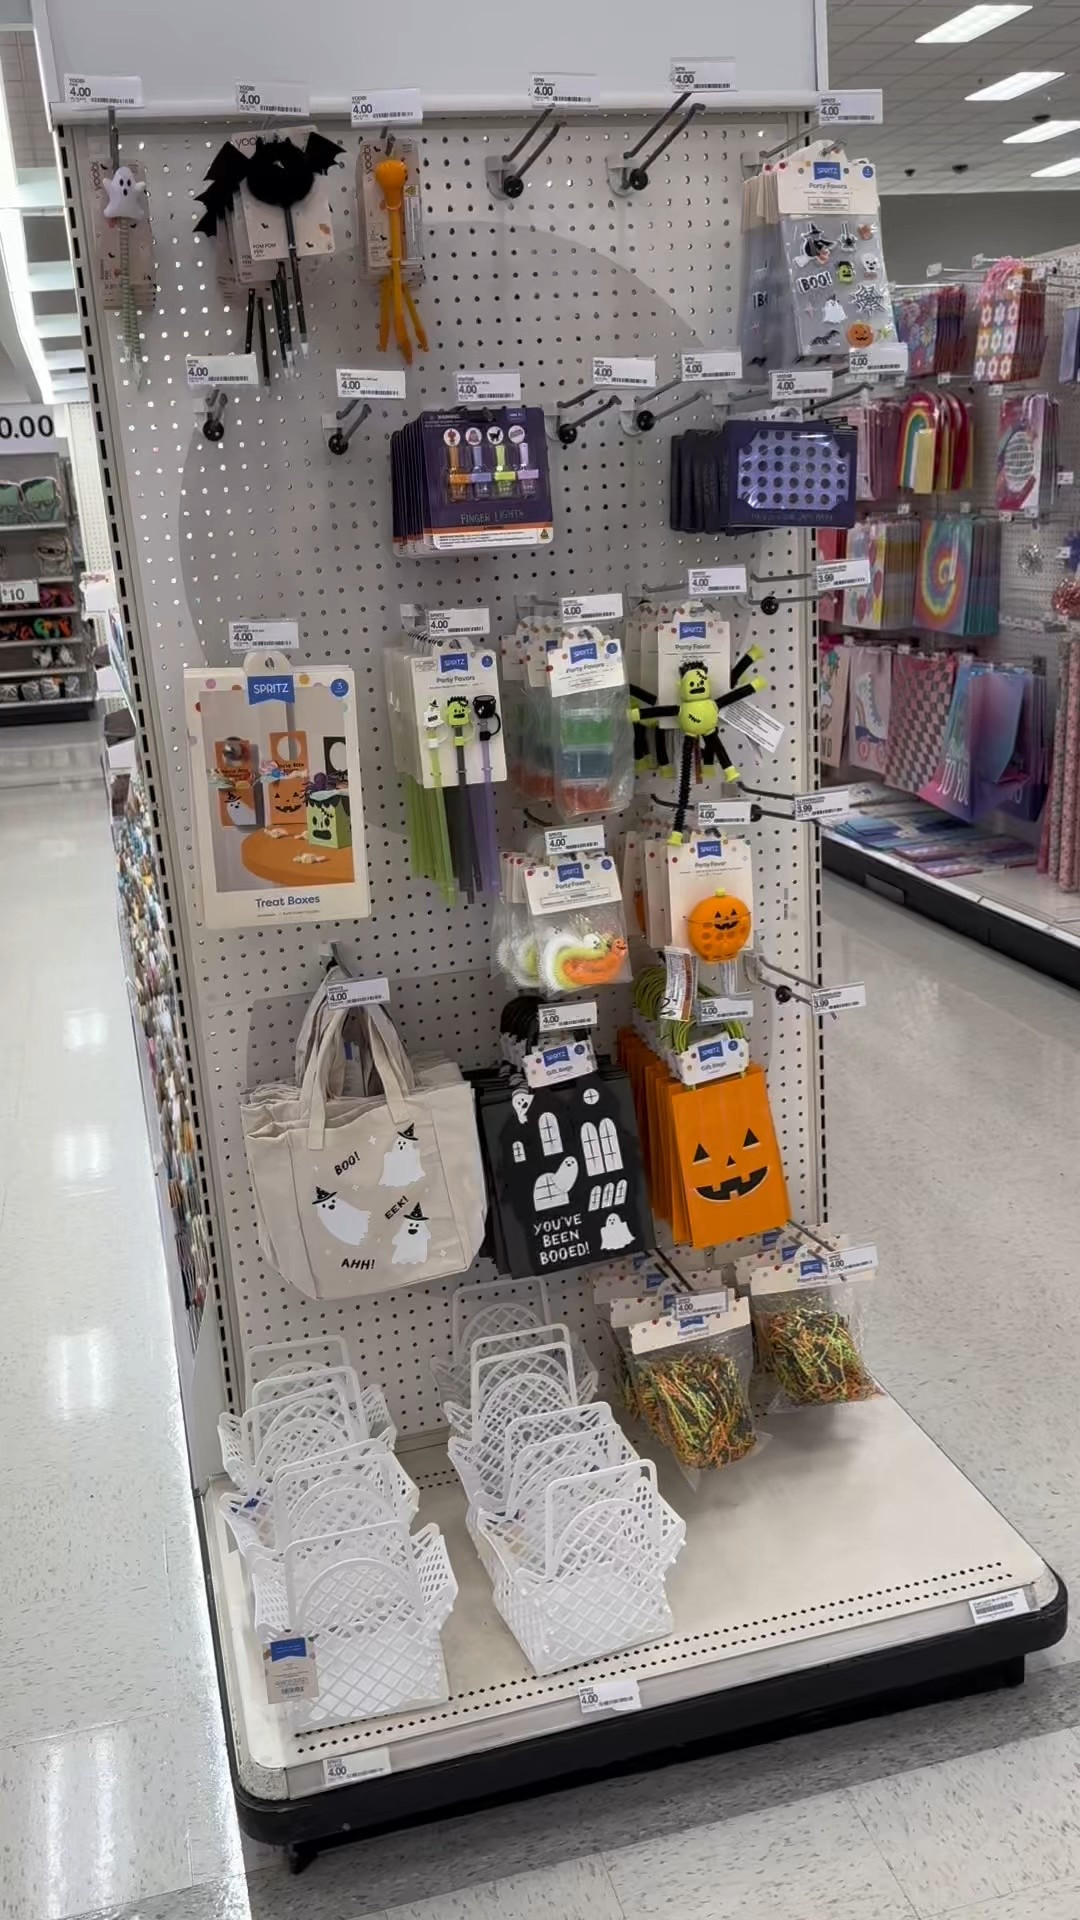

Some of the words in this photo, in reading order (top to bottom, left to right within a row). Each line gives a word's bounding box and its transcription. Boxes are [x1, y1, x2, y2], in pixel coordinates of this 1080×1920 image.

[676, 75, 694, 84] 4.00
[70, 87, 91, 97] 4.00
[534, 87, 553, 96] 4.00
[240, 95, 260, 105] 4.00
[353, 104, 373, 114] 4.00
[821, 106, 839, 115] 4.00
[851, 357, 868, 366] 4.00
[187, 367, 208, 377] 4.00
[594, 368, 612, 377] 4.00
[685, 364, 702, 373] 4.00
[342, 381, 361, 390] 4.00
[458, 385, 477, 394] 4.00
[777, 381, 794, 390] 4.00
[461, 512, 490, 524] FINGER
[563, 606, 581, 615] 4.00
[430, 620, 448, 629] 4.00
[234, 633, 253, 641] 4.00
[253, 682, 289, 694] SPRITZ
[700, 811, 715, 819] 4.00
[549, 838, 566, 848] 4.00
[255, 898, 285, 908] Treat
[287, 896, 320, 905] Boxes
[329, 993, 347, 1002] 4.00
[702, 1007, 718, 1015] 4.00
[543, 1015, 560, 1024] 4.00
[335, 1151, 360, 1176] BOO!
[385, 1195, 409, 1220] EEK!
[534, 1213, 582, 1236] YOU'VE
[543, 1229, 579, 1248] BEEN
[540, 1241, 590, 1265] BOOED!
[340, 1258, 375, 1270] AHH!
[830, 1260, 844, 1268] 4.00
[679, 1303, 694, 1311] 4.00
[581, 1694, 599, 1704] 4.00
[328, 1766, 347, 1777] 4.00
